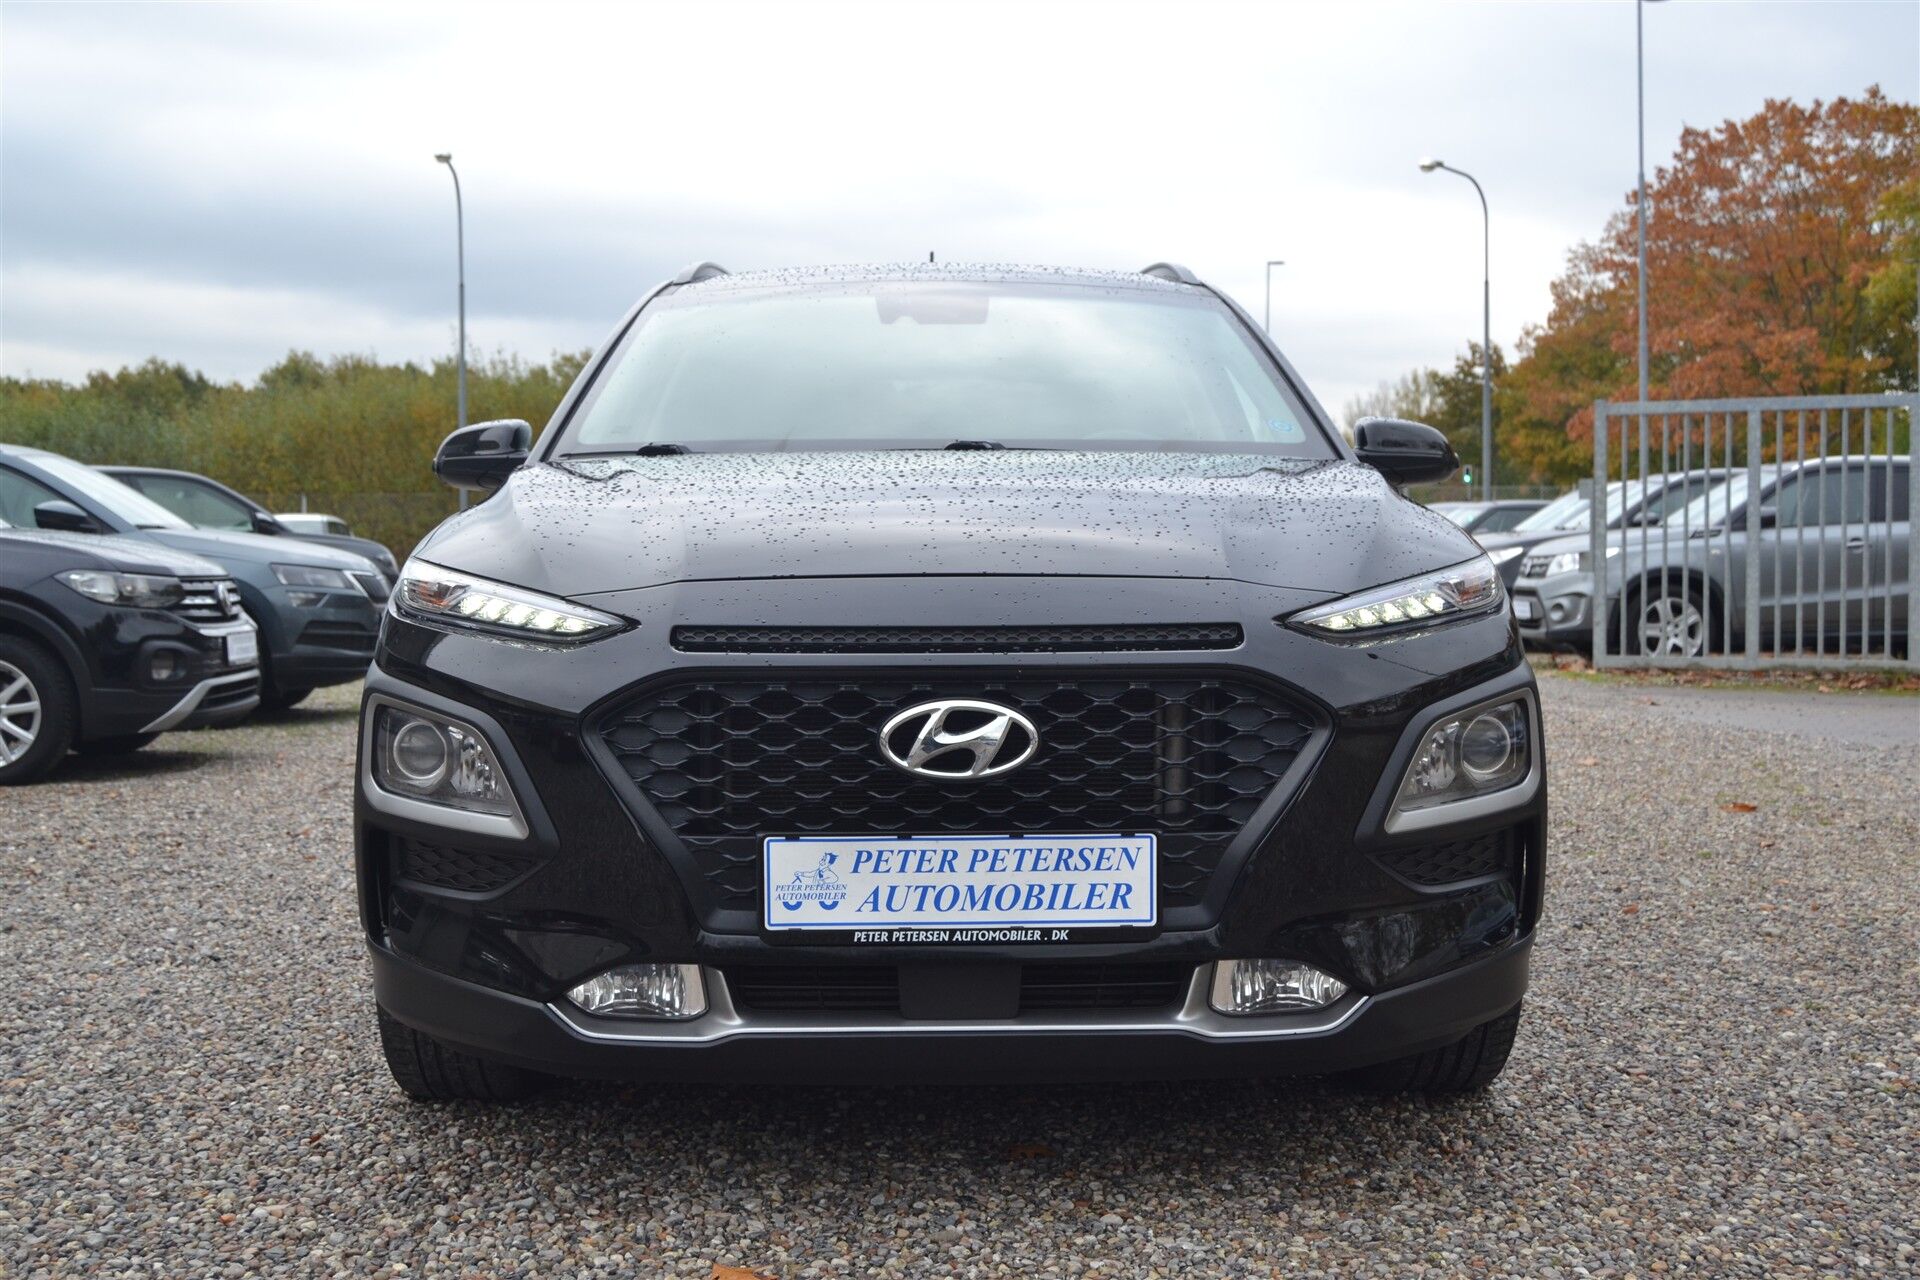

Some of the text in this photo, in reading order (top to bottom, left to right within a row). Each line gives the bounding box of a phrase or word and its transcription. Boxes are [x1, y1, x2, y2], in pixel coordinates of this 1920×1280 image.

[849, 847, 1142, 874] PETER PETERSEN
[775, 883, 847, 892] PETER PETERSEN
[775, 892, 847, 901] AUTOMOBILER
[855, 882, 1133, 913] AUTOMOBILER
[853, 931, 888, 942] PETER
[892, 930, 950, 942] PETERSEN
[952, 929, 1041, 941] AUTOMOBILER
